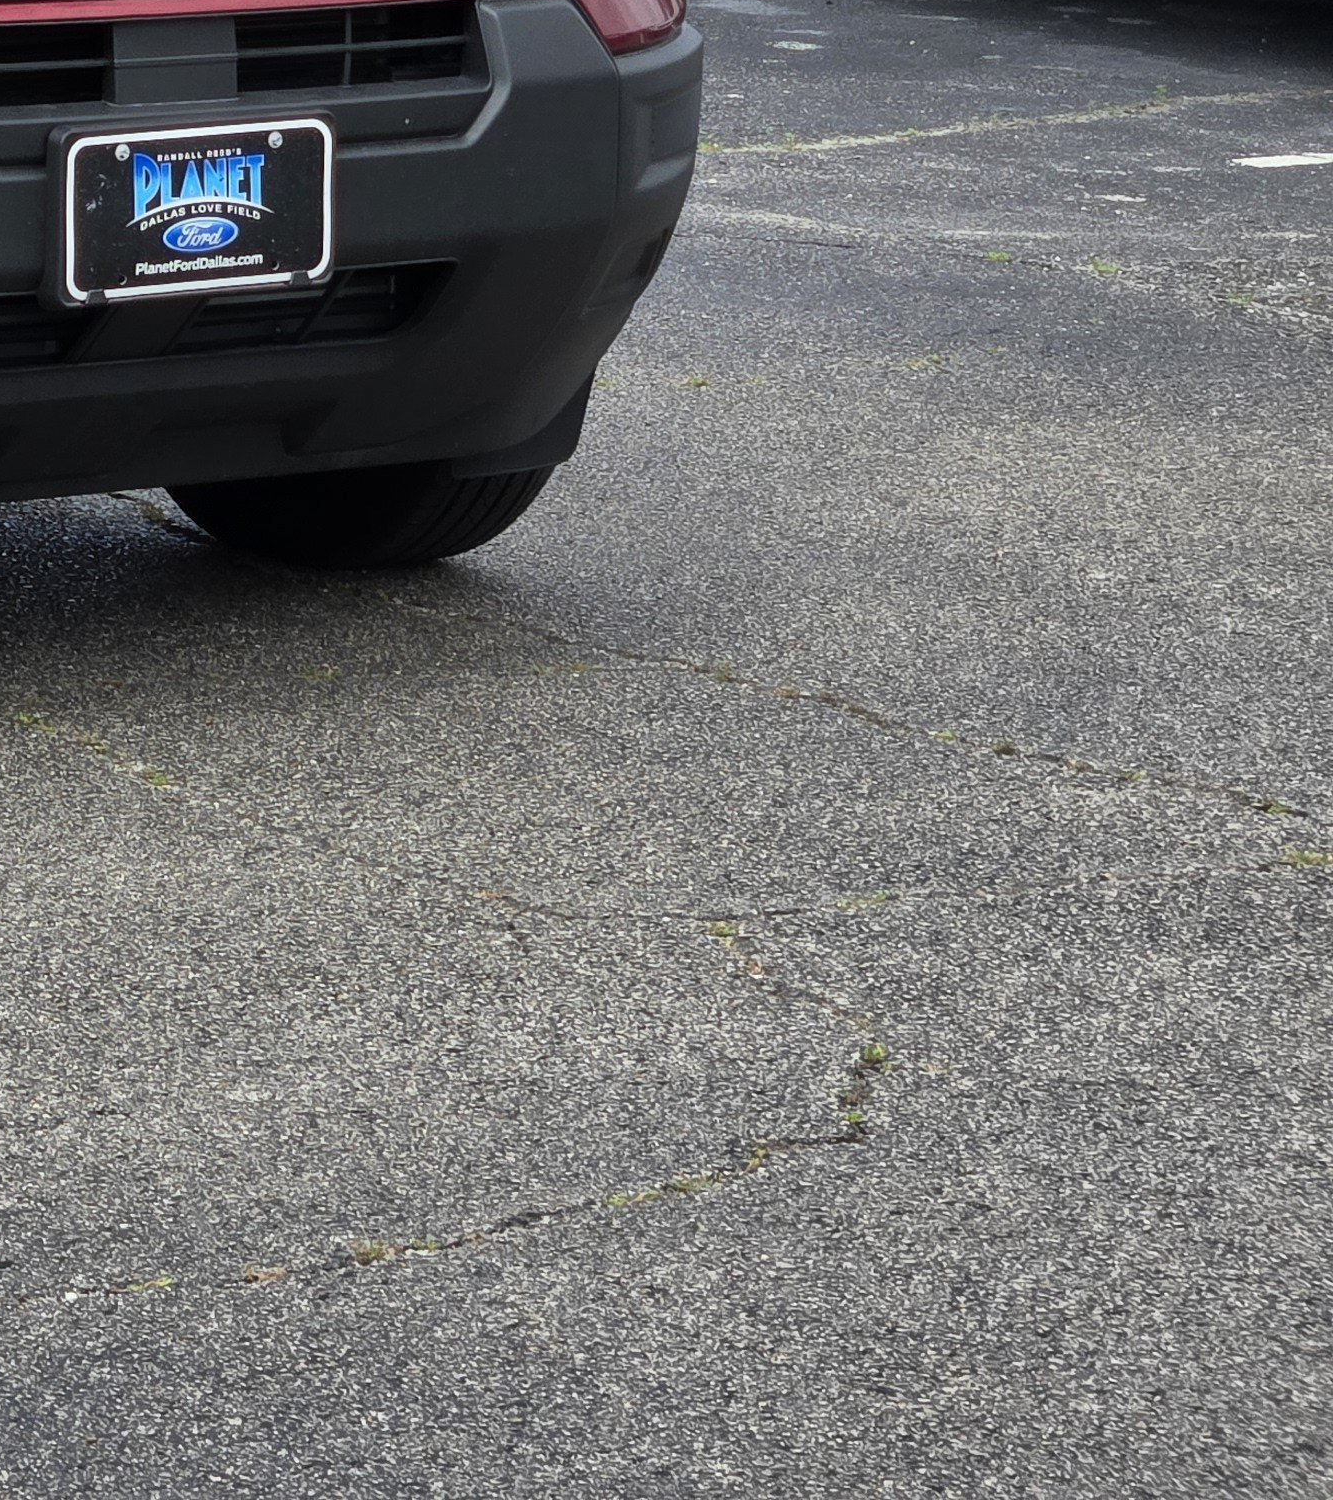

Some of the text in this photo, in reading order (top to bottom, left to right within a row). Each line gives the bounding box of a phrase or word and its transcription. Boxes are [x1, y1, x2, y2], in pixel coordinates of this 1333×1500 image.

[133, 152, 265, 221] PLANET
[140, 204, 262, 232] DALLAS LOVE FIELD
[177, 222, 223, 247] Ford
[135, 252, 264, 276] PlanetFordDallas.com
